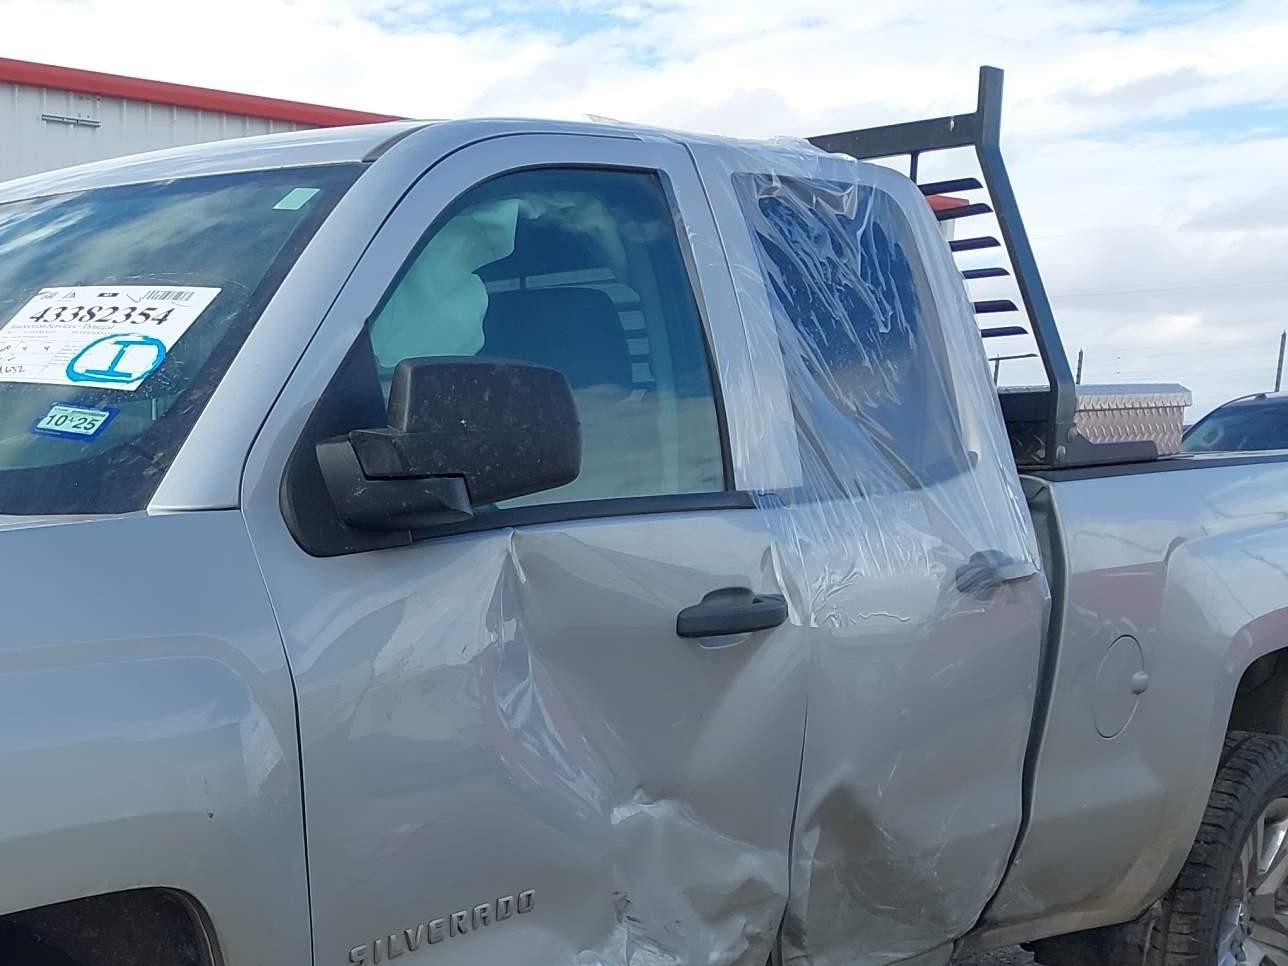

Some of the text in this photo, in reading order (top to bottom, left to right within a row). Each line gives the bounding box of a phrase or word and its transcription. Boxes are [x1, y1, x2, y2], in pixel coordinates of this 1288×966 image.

[29, 305, 175, 326] 43382354
[45, 414, 99, 431] 10 25
